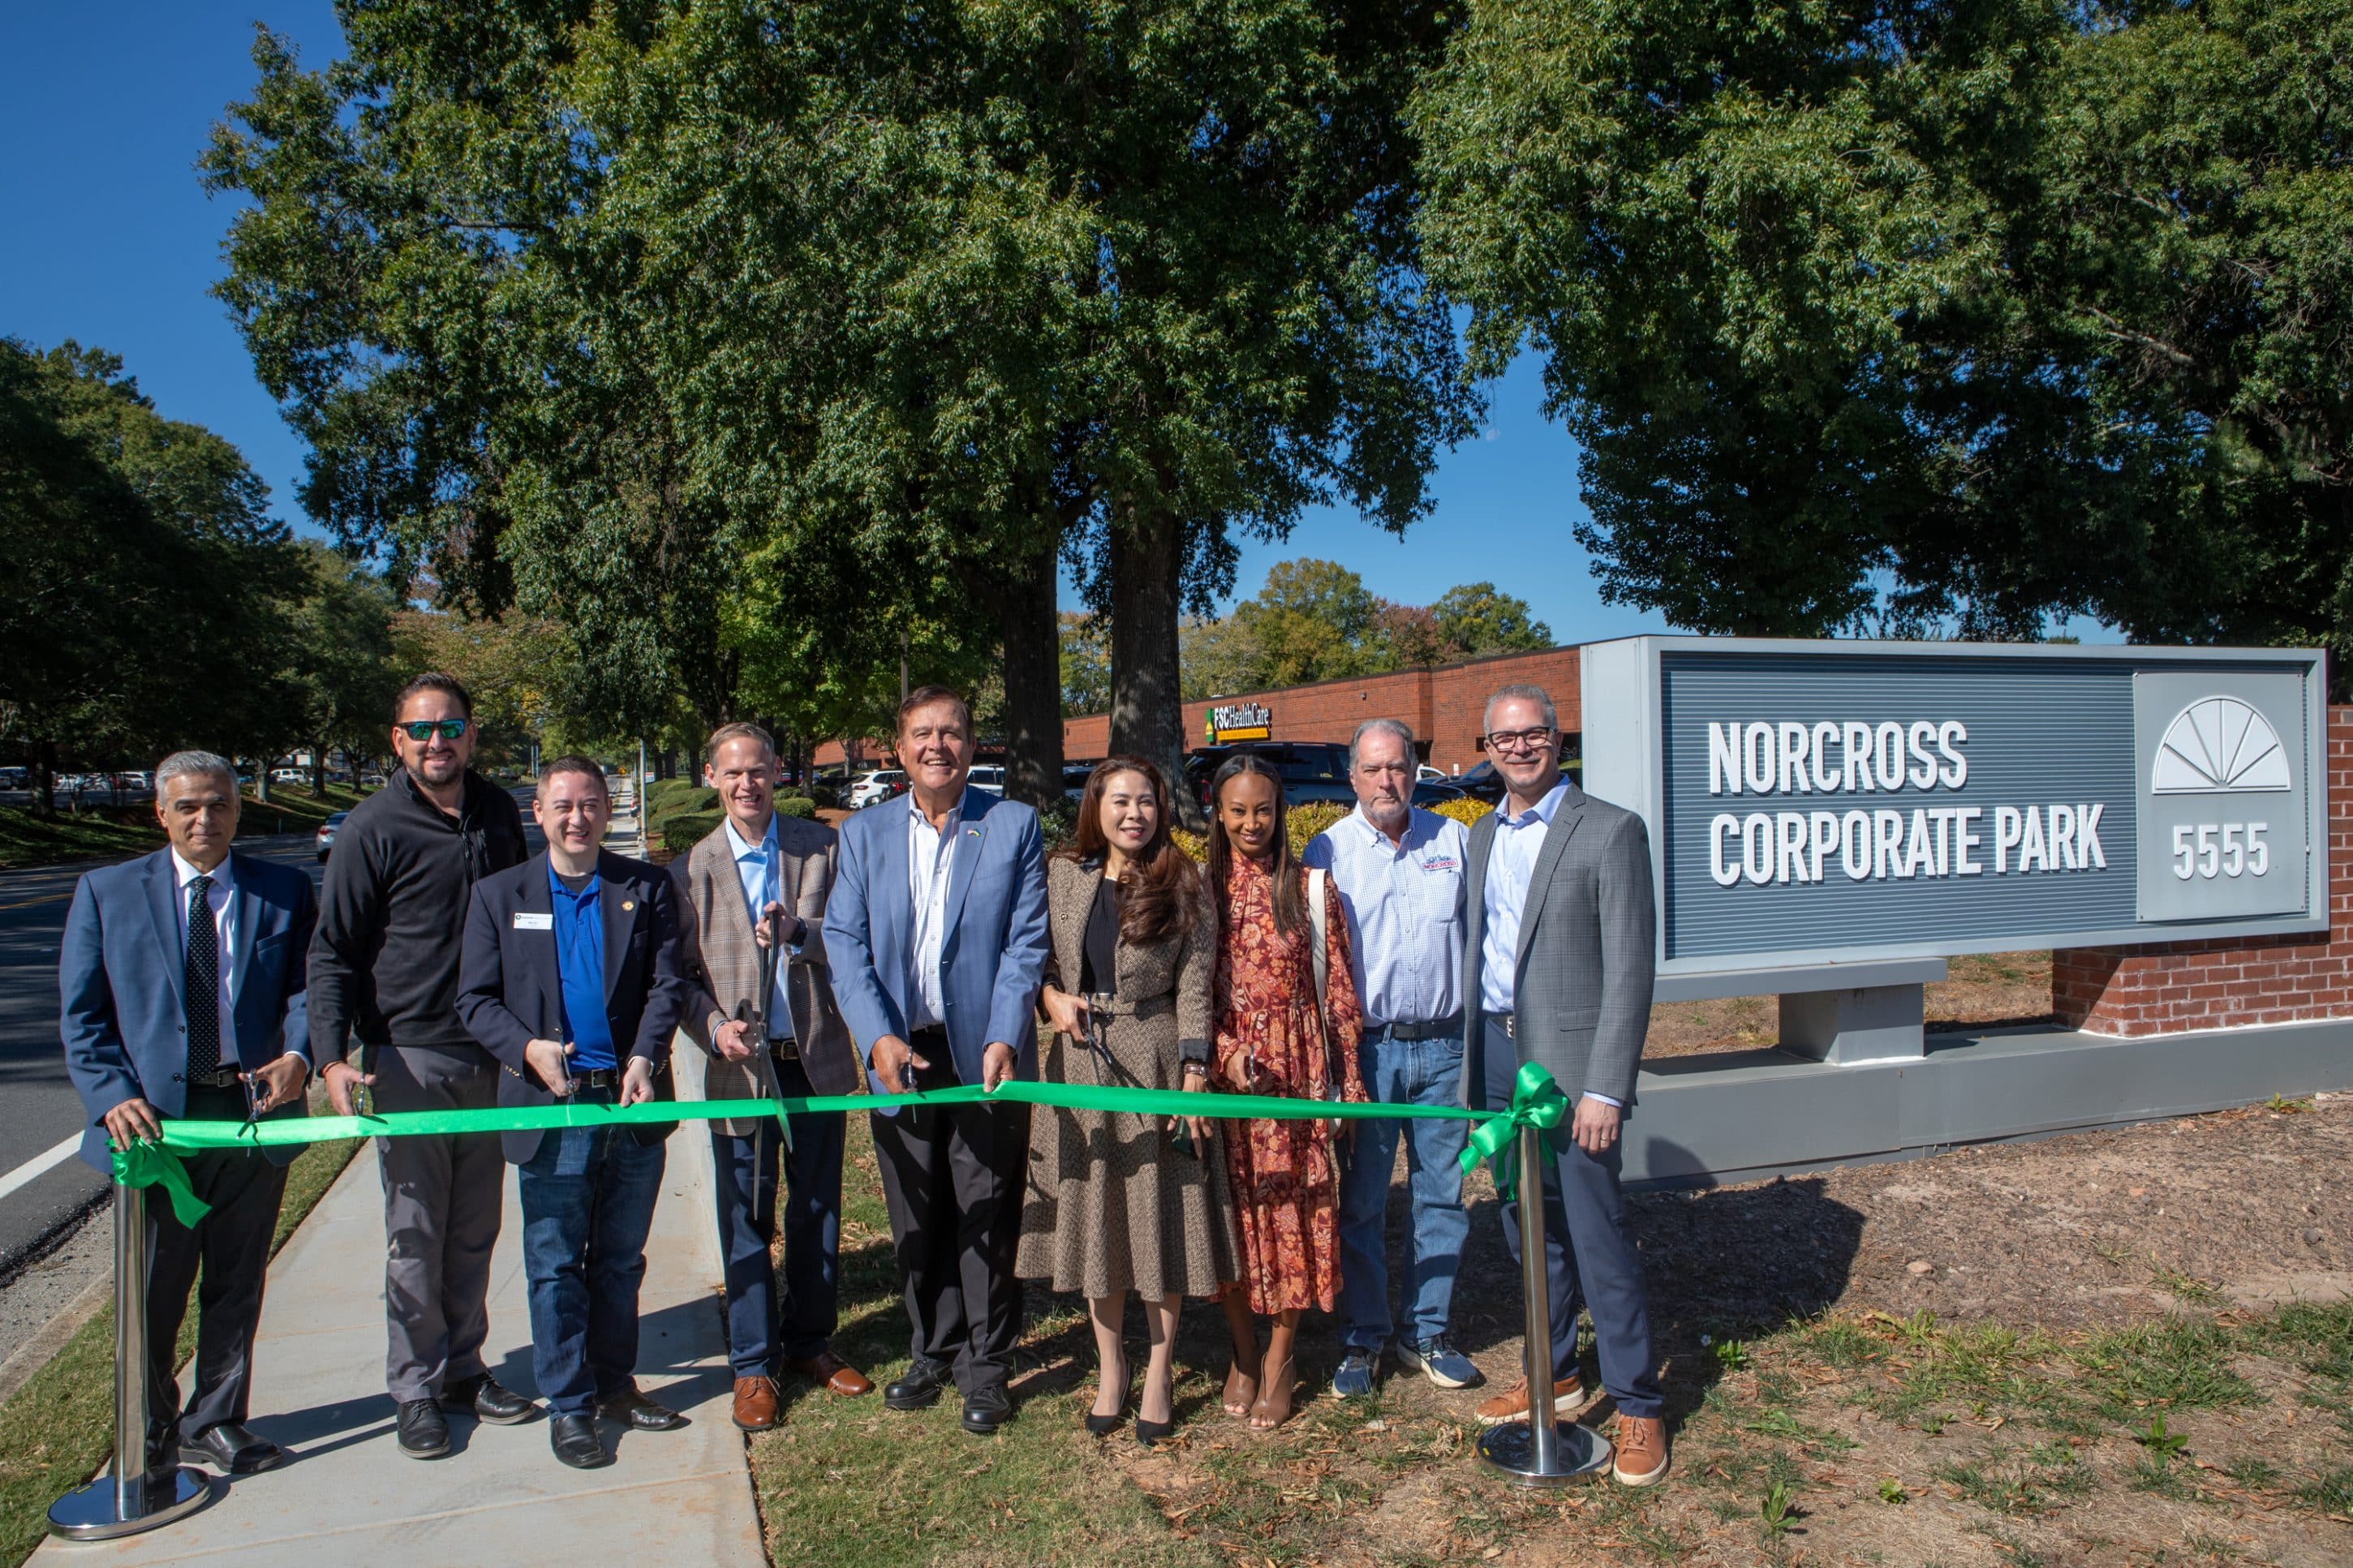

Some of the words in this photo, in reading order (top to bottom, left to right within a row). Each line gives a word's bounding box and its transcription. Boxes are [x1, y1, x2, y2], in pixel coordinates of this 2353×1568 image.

[1708, 721, 1968, 794] NORCROSS
[1710, 808, 1982, 886] CORPORATE
[1995, 804, 2107, 873] PARK
[2173, 823, 2269, 879] 5555
